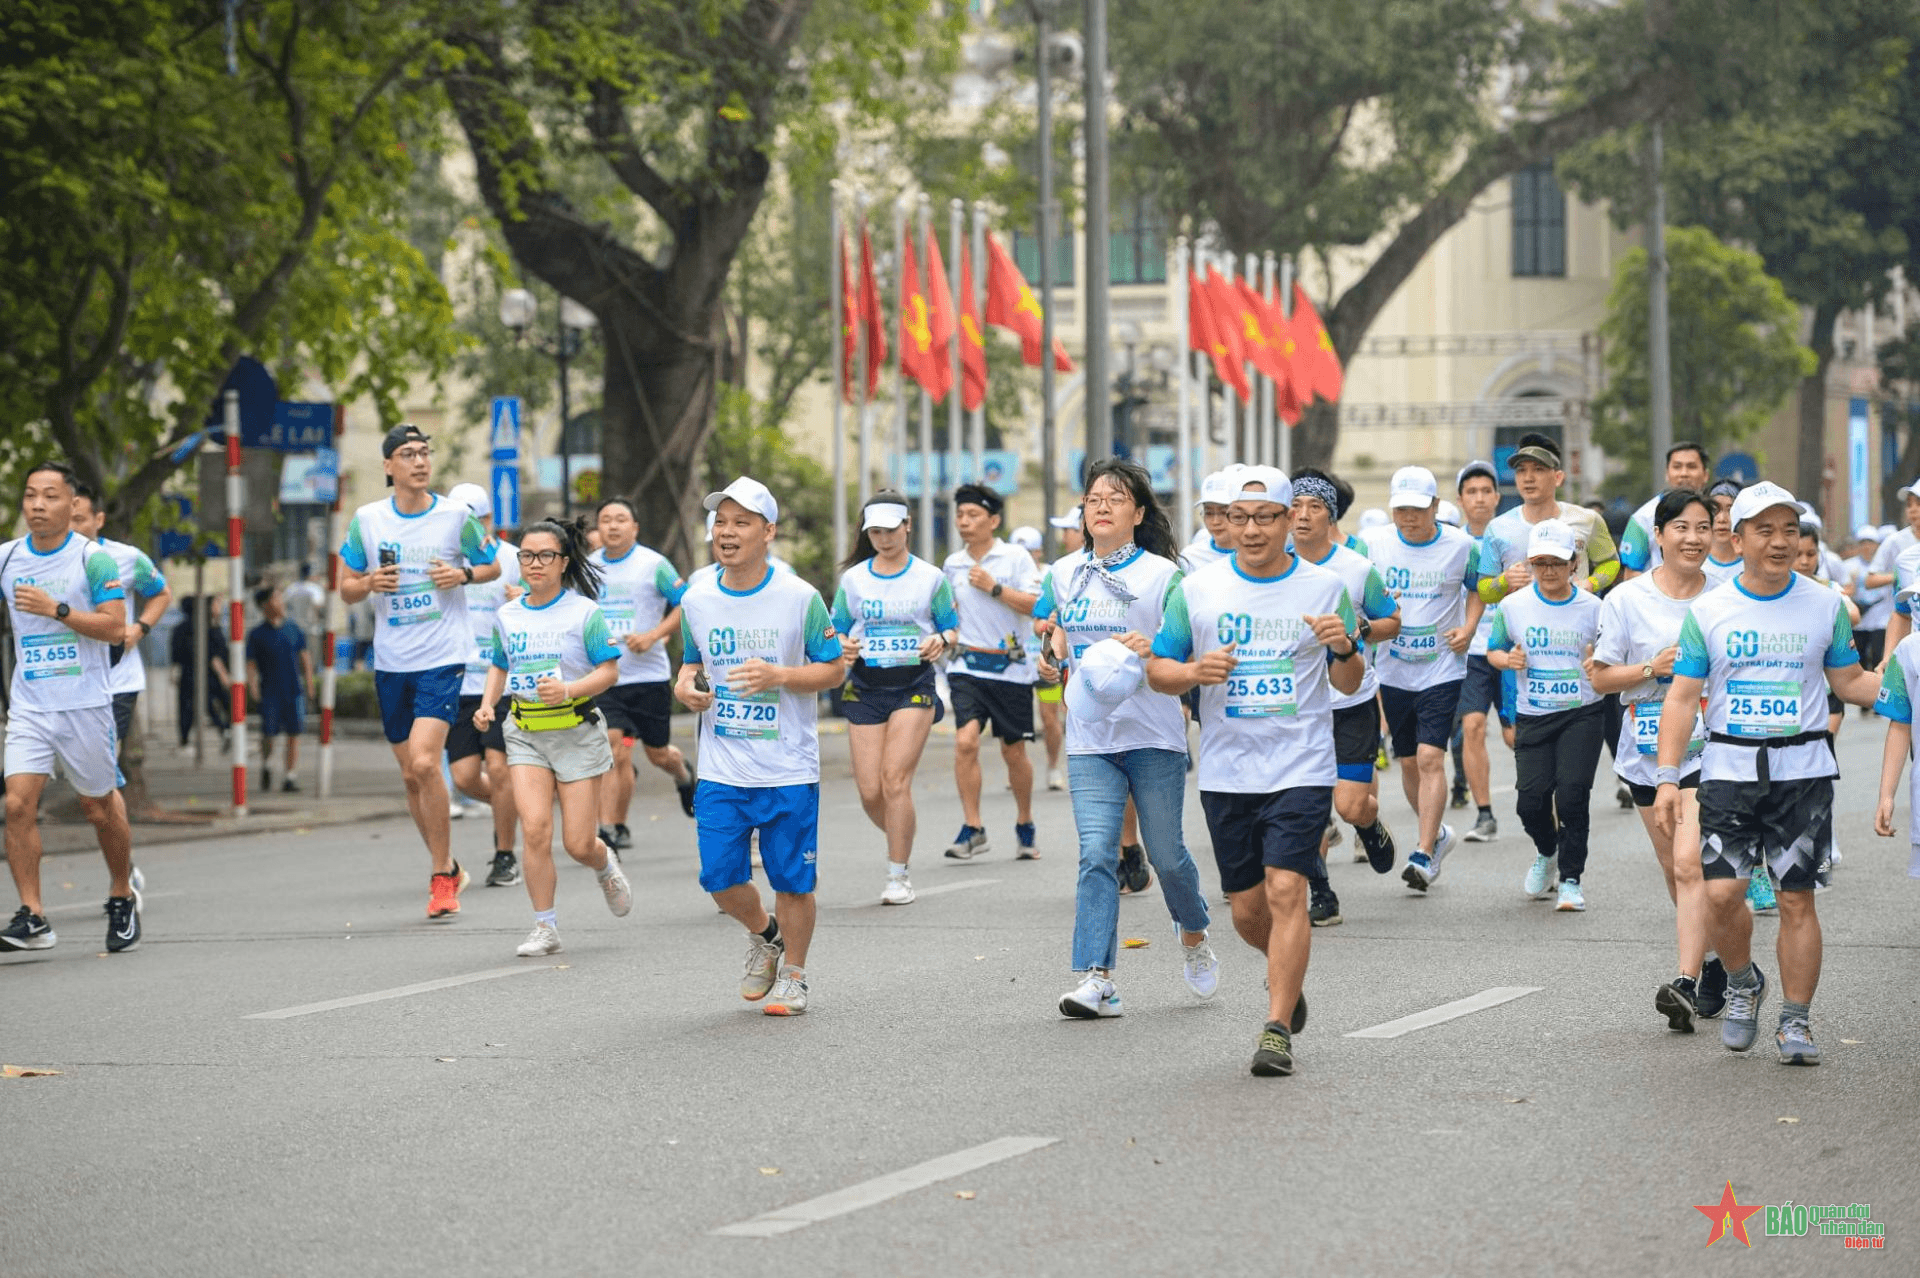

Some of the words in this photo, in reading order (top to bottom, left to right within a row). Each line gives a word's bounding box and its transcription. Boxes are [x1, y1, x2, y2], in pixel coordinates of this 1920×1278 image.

[1386, 566, 1410, 590] 60
[862, 599, 883, 620] 60
[1063, 597, 1090, 623] 60
[1089, 608, 1127, 618] HOUR
[1218, 612, 1252, 646] 60
[1254, 618, 1306, 630] EARTH
[709, 626, 736, 657] 60
[736, 628, 780, 640] EARTH
[1254, 629, 1300, 641] HOUR
[1526, 626, 1549, 648] 60
[1760, 632, 1808, 644] EARTH
[737, 638, 777, 650] HOUR
[868, 638, 918, 652] 25.532
[1726, 629, 1759, 659] 60
[1760, 643, 1804, 654] HOUR
[24, 645, 77, 664] 25.655
[1226, 677, 1293, 697] 25.633
[1528, 681, 1579, 694] 25.406
[716, 702, 776, 722] 25.720
[1730, 697, 1798, 717] 25.504
